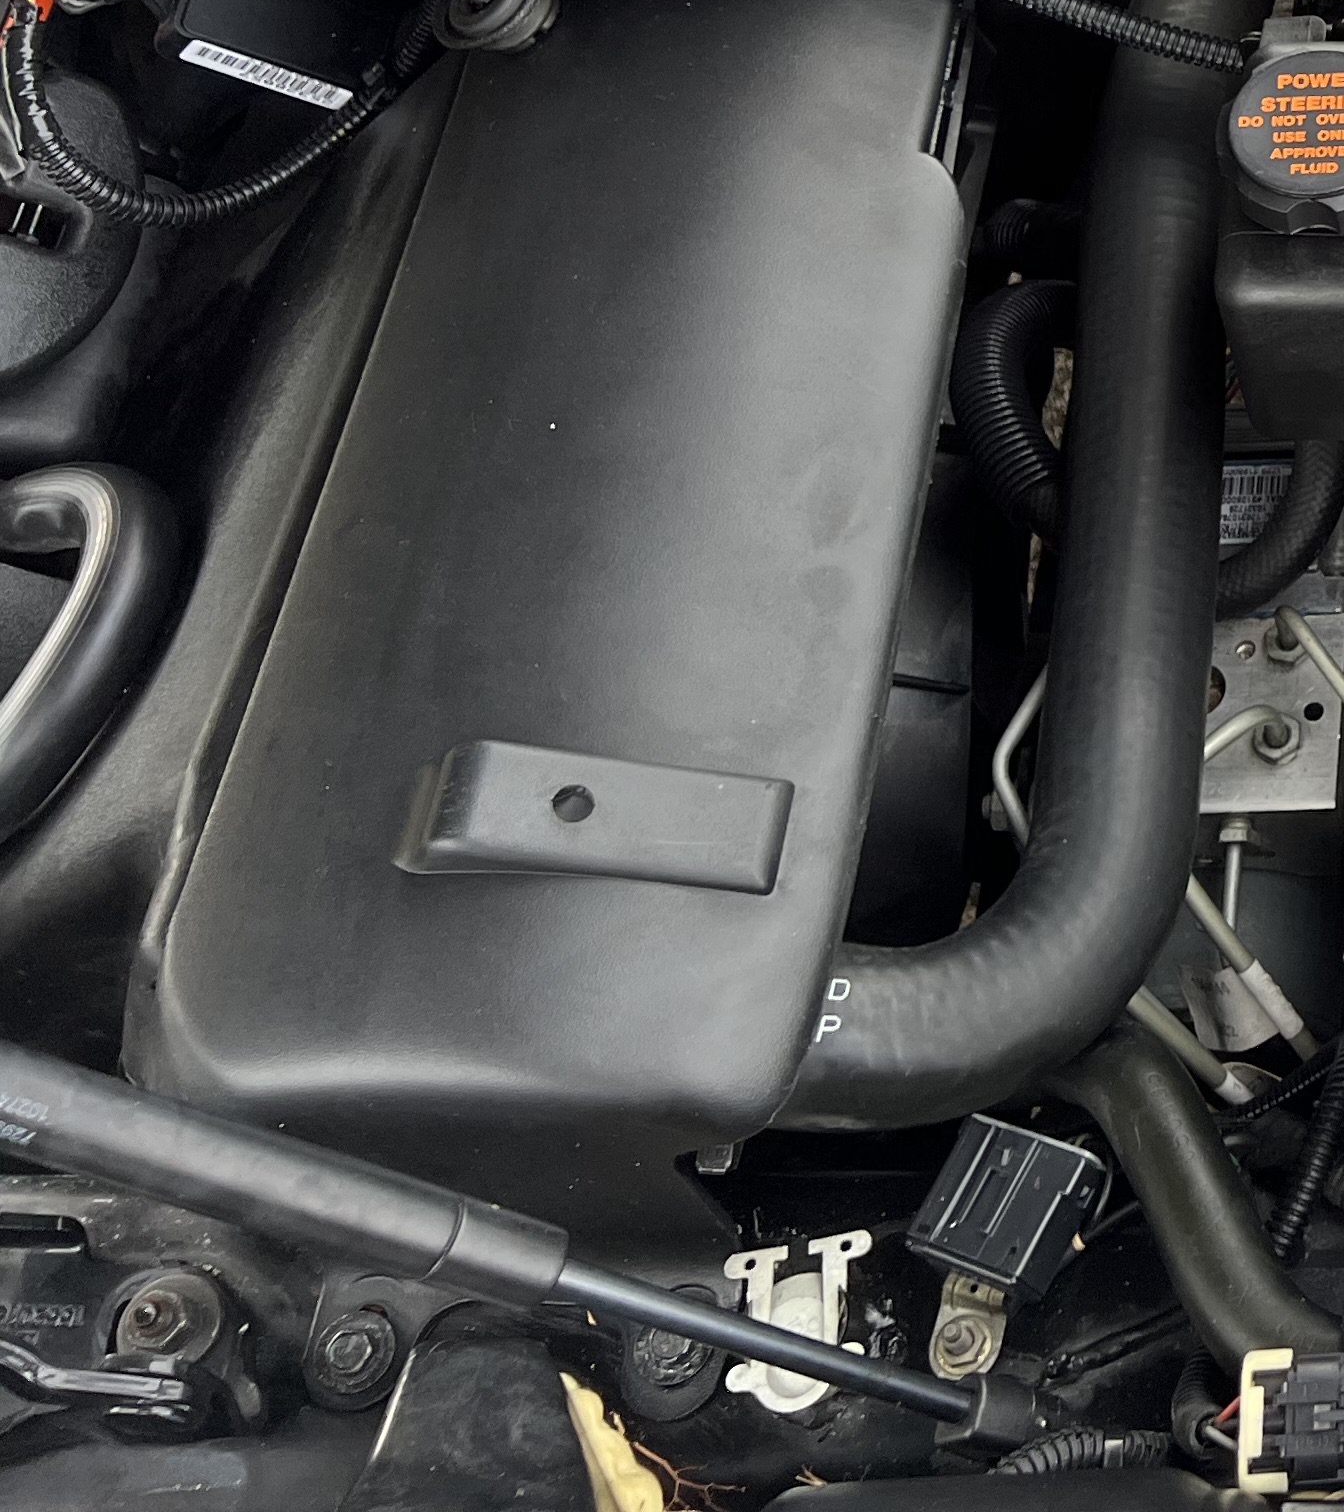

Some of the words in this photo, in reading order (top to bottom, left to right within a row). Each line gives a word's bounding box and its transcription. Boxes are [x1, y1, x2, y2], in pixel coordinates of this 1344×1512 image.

[1238, 114, 1263, 129] DO
[1271, 114, 1306, 128] NOT
[1272, 129, 1307, 143] USE
[1290, 161, 1339, 175] FLUID
